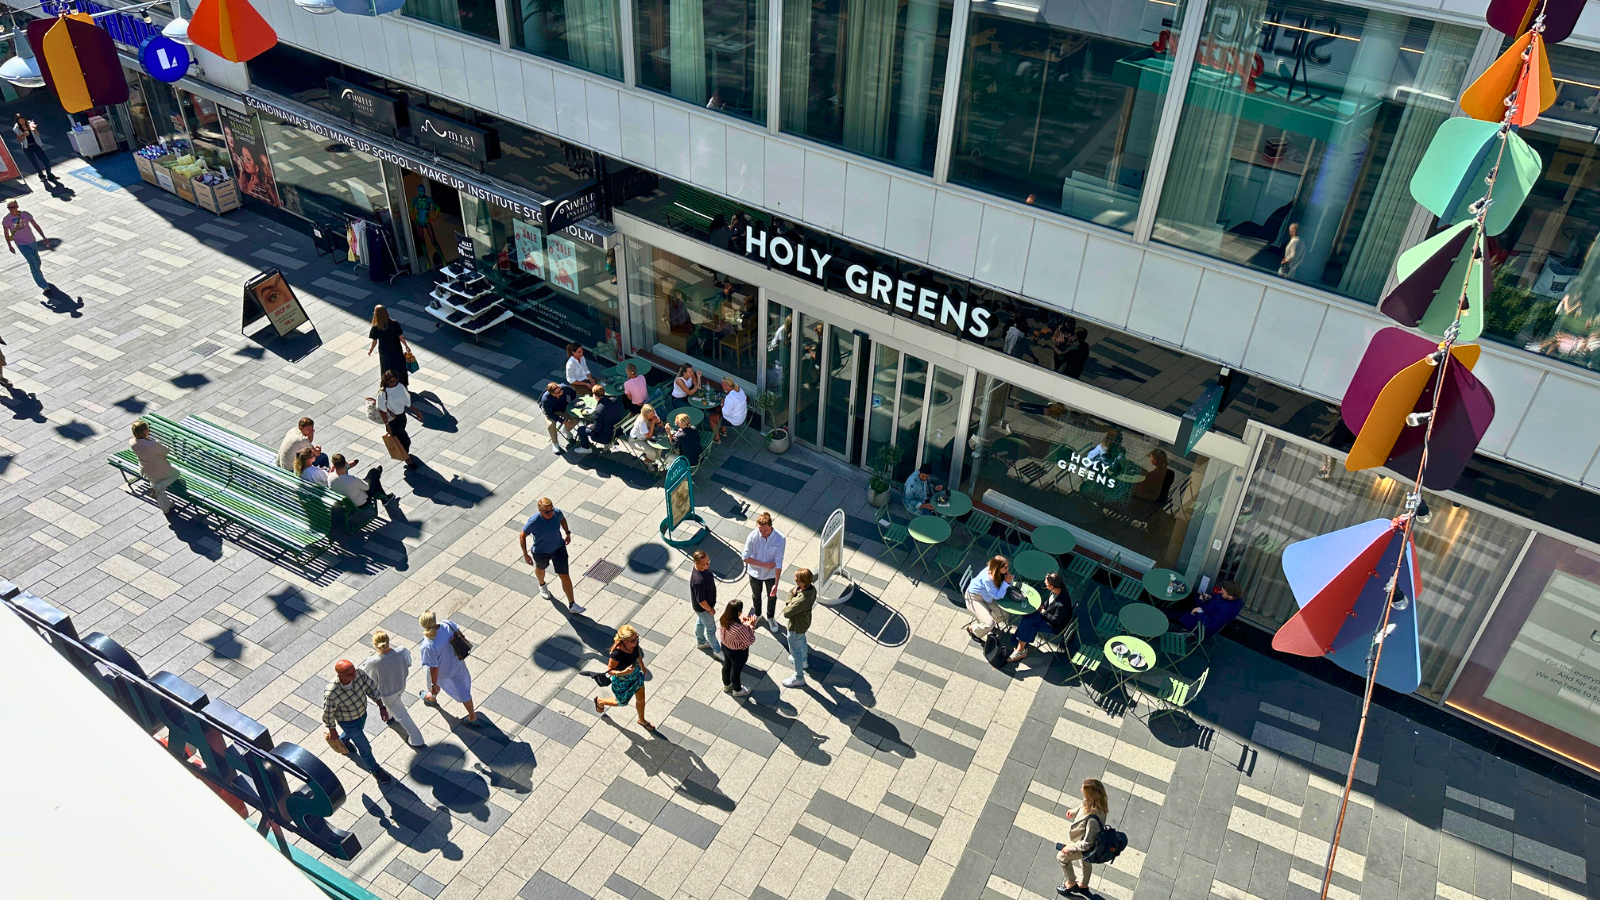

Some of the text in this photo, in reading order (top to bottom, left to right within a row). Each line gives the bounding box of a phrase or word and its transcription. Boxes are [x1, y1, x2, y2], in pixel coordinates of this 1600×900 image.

[447, 130, 476, 148] mist
[245, 96, 308, 129] SCANDINAVIA'S
[309, 122, 329, 138] NO.1
[329, 130, 356, 149] MAKE
[356, 140, 370, 153] UP
[372, 146, 412, 171] SCHOOL
[419, 164, 449, 185] MAKE
[450, 177, 465, 190] UP
[468, 185, 521, 214] INSTITUTE
[522, 228, 537, 243] SALE
[555, 242, 571, 257] SALE
[746, 225, 992, 338] HOLY GREENS
[1070, 452, 1110, 474] HOLY
[1057, 459, 1116, 489] GREENS
[1545, 657, 1558, 668] For
[1559, 663, 1574, 674] the
[1535, 670, 1549, 680] We
[1549, 677, 1563, 686] are
[1563, 681, 1582, 694] here
[1582, 689, 1592, 698] to
[1557, 671, 1598, 692] And for all
